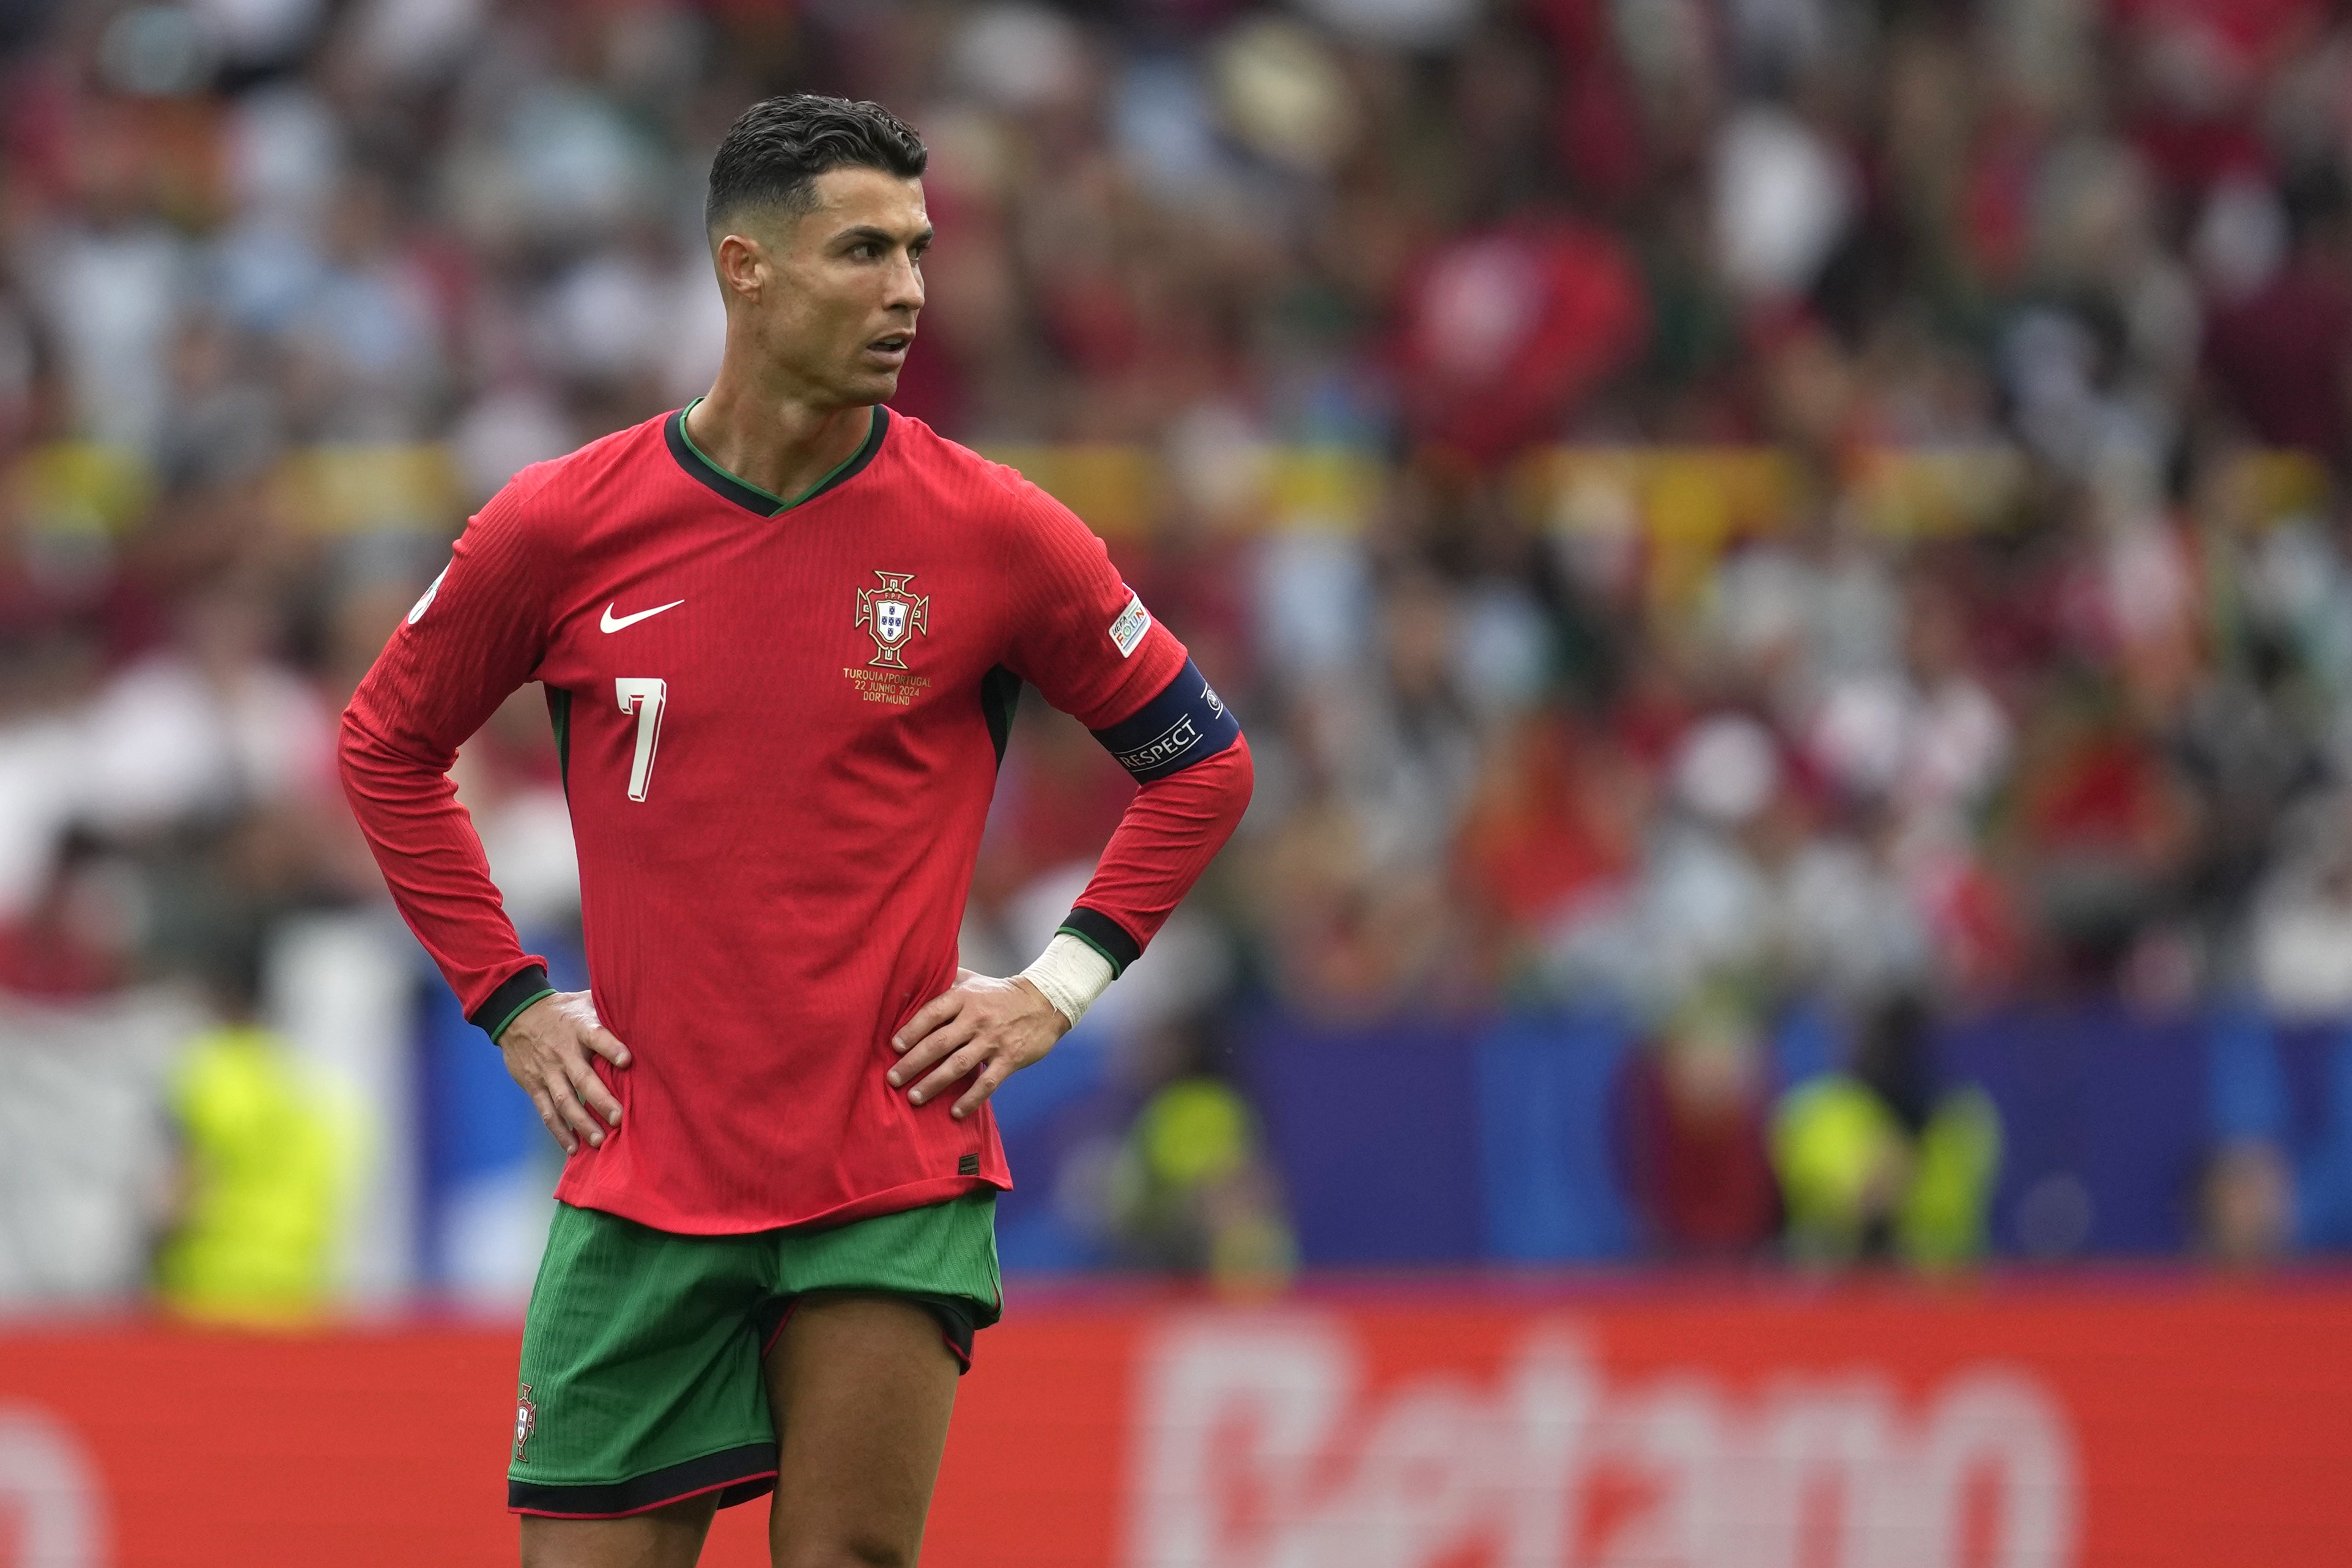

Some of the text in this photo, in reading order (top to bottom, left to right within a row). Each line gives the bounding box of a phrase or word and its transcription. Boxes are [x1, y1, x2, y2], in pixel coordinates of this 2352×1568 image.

[1112, 615, 1127, 637] UEFA
[843, 668, 931, 687] TURQUIA/PORTUGAL
[854, 680, 920, 697] 22 JUNHO 2024
[863, 691, 910, 706] DORTMUND
[615, 678, 667, 802] 7
[1120, 719, 1197, 768] RESPECT
